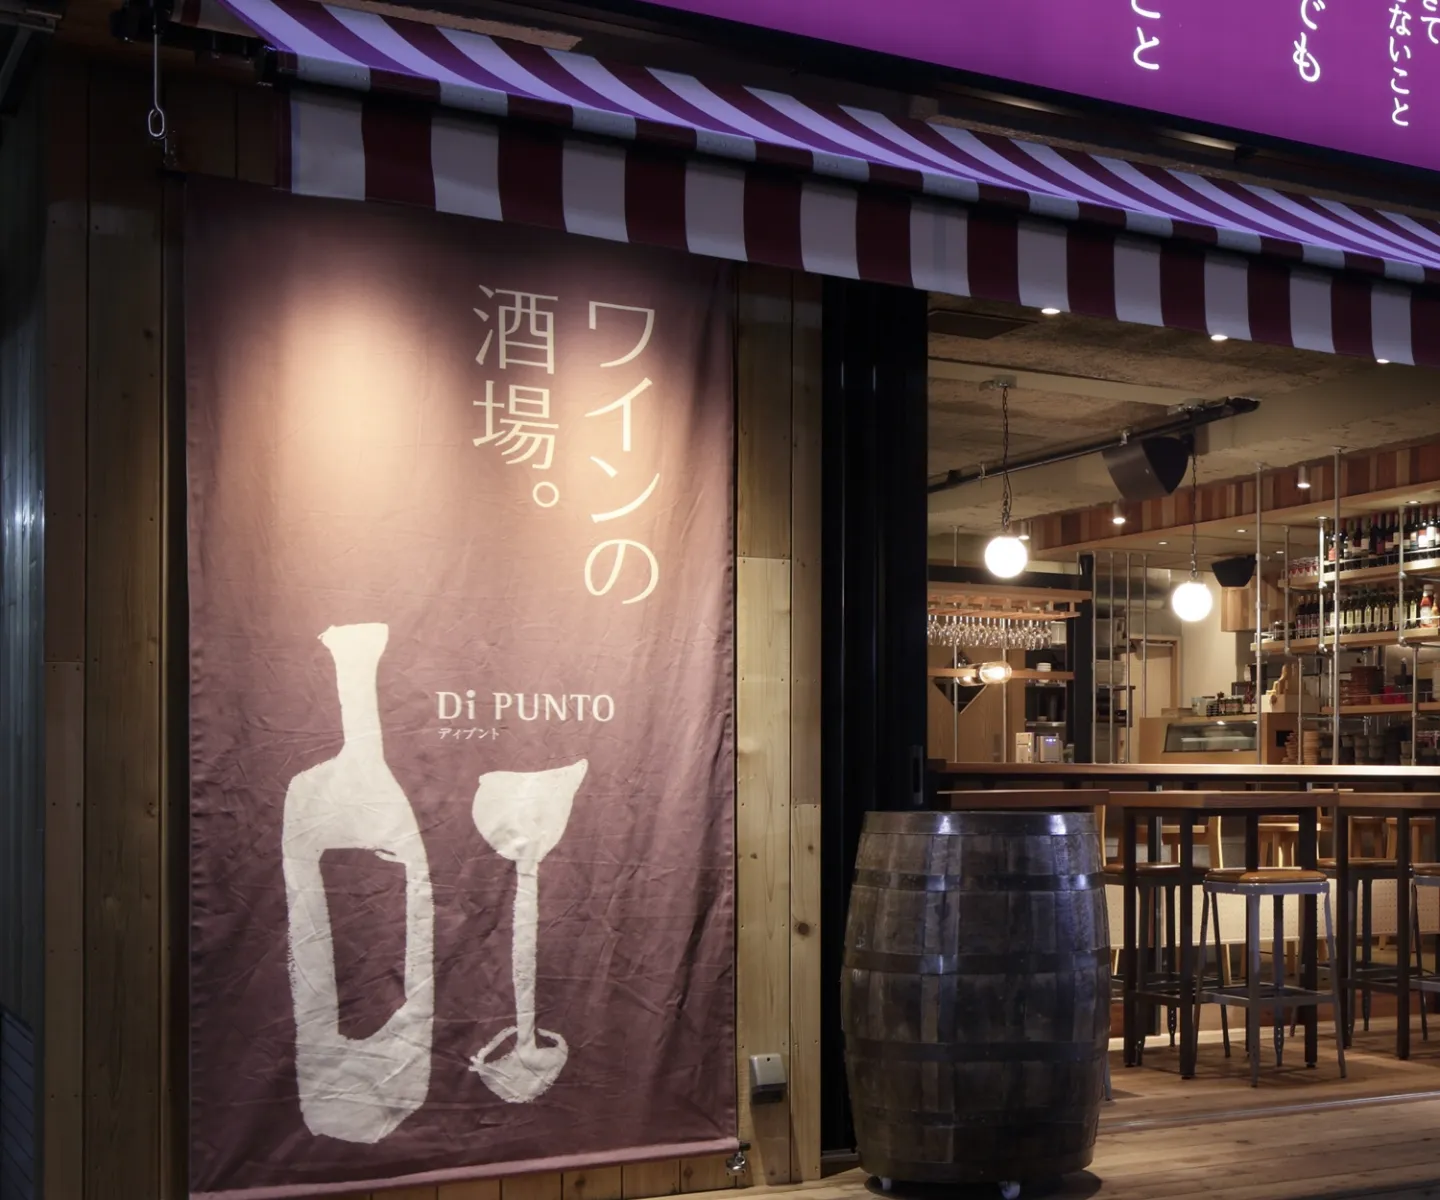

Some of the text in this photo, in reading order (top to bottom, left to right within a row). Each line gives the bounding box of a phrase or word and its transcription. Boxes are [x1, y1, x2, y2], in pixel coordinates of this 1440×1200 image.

[1388, 0, 1412, 127] ないこと
[472, 284, 560, 508] 酒場。
[584, 300, 660, 604] ワインの
[435, 689, 615, 722] Di PUNTO
